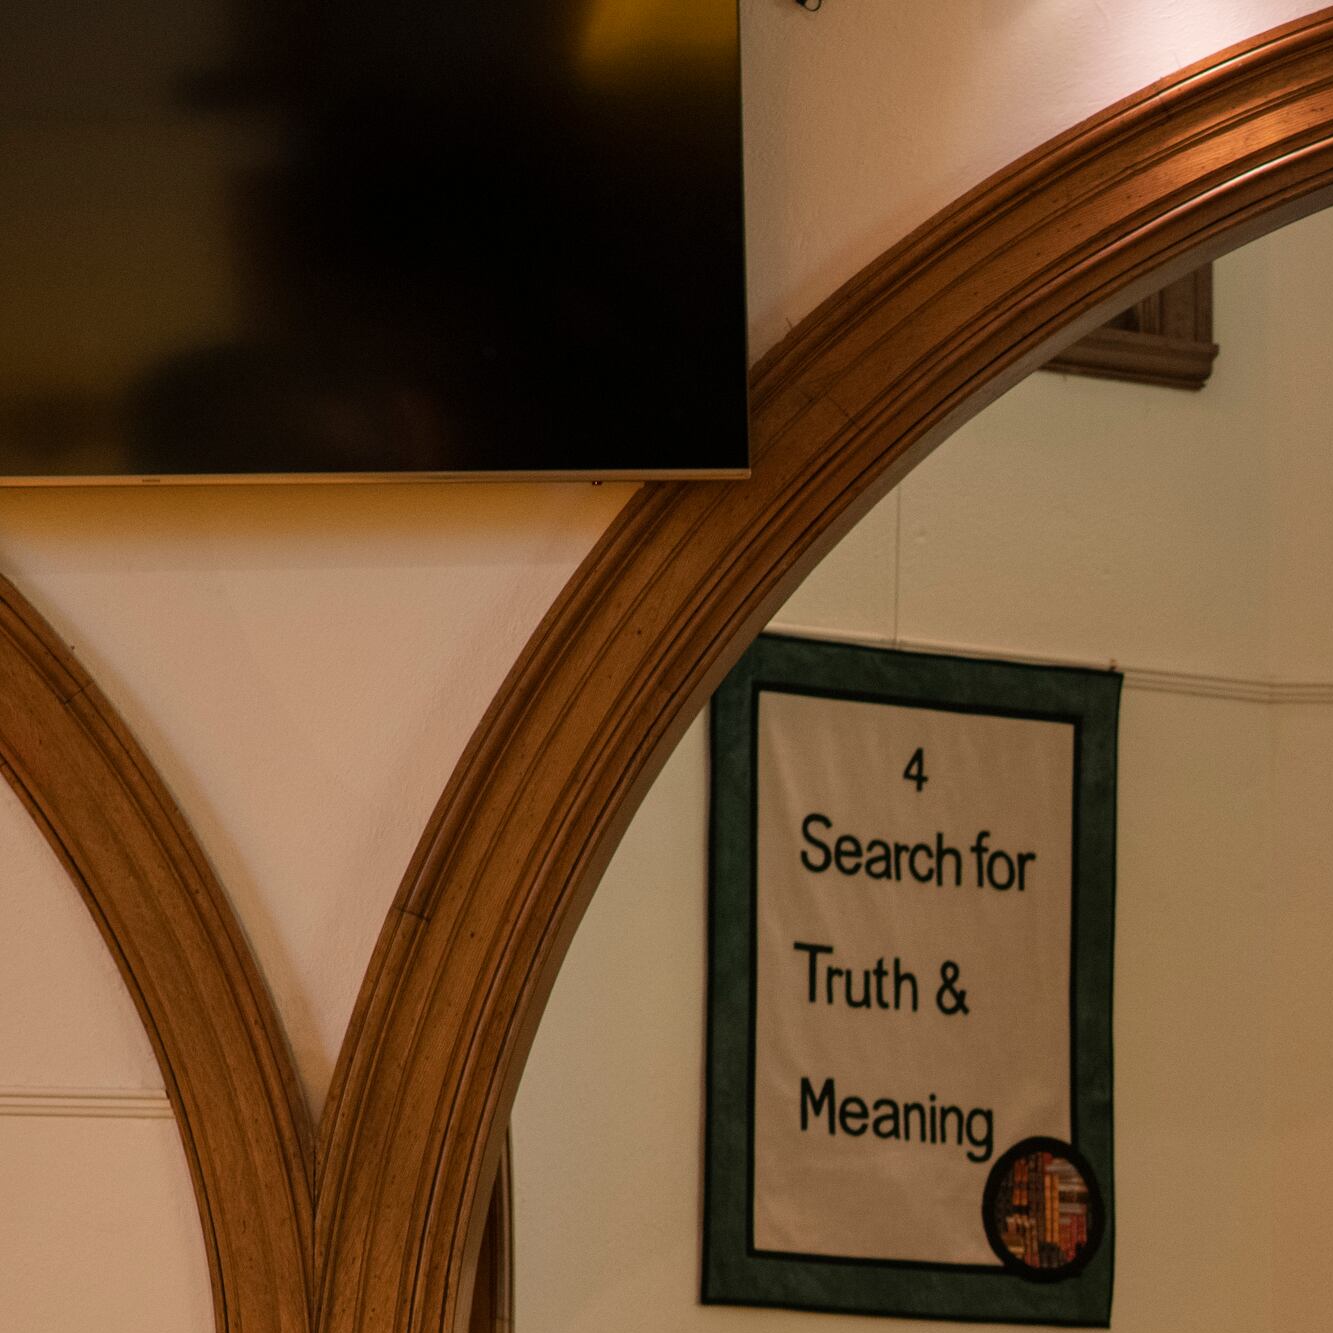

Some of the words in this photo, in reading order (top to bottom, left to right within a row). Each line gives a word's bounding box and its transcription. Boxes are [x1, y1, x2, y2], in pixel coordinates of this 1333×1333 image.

[902, 747, 929, 793] 4
[800, 812, 963, 888] Search
[969, 830, 1038, 892] for
[793, 941, 919, 1013] Truth
[935, 959, 970, 1016] &
[799, 1076, 994, 1164] Meaning
